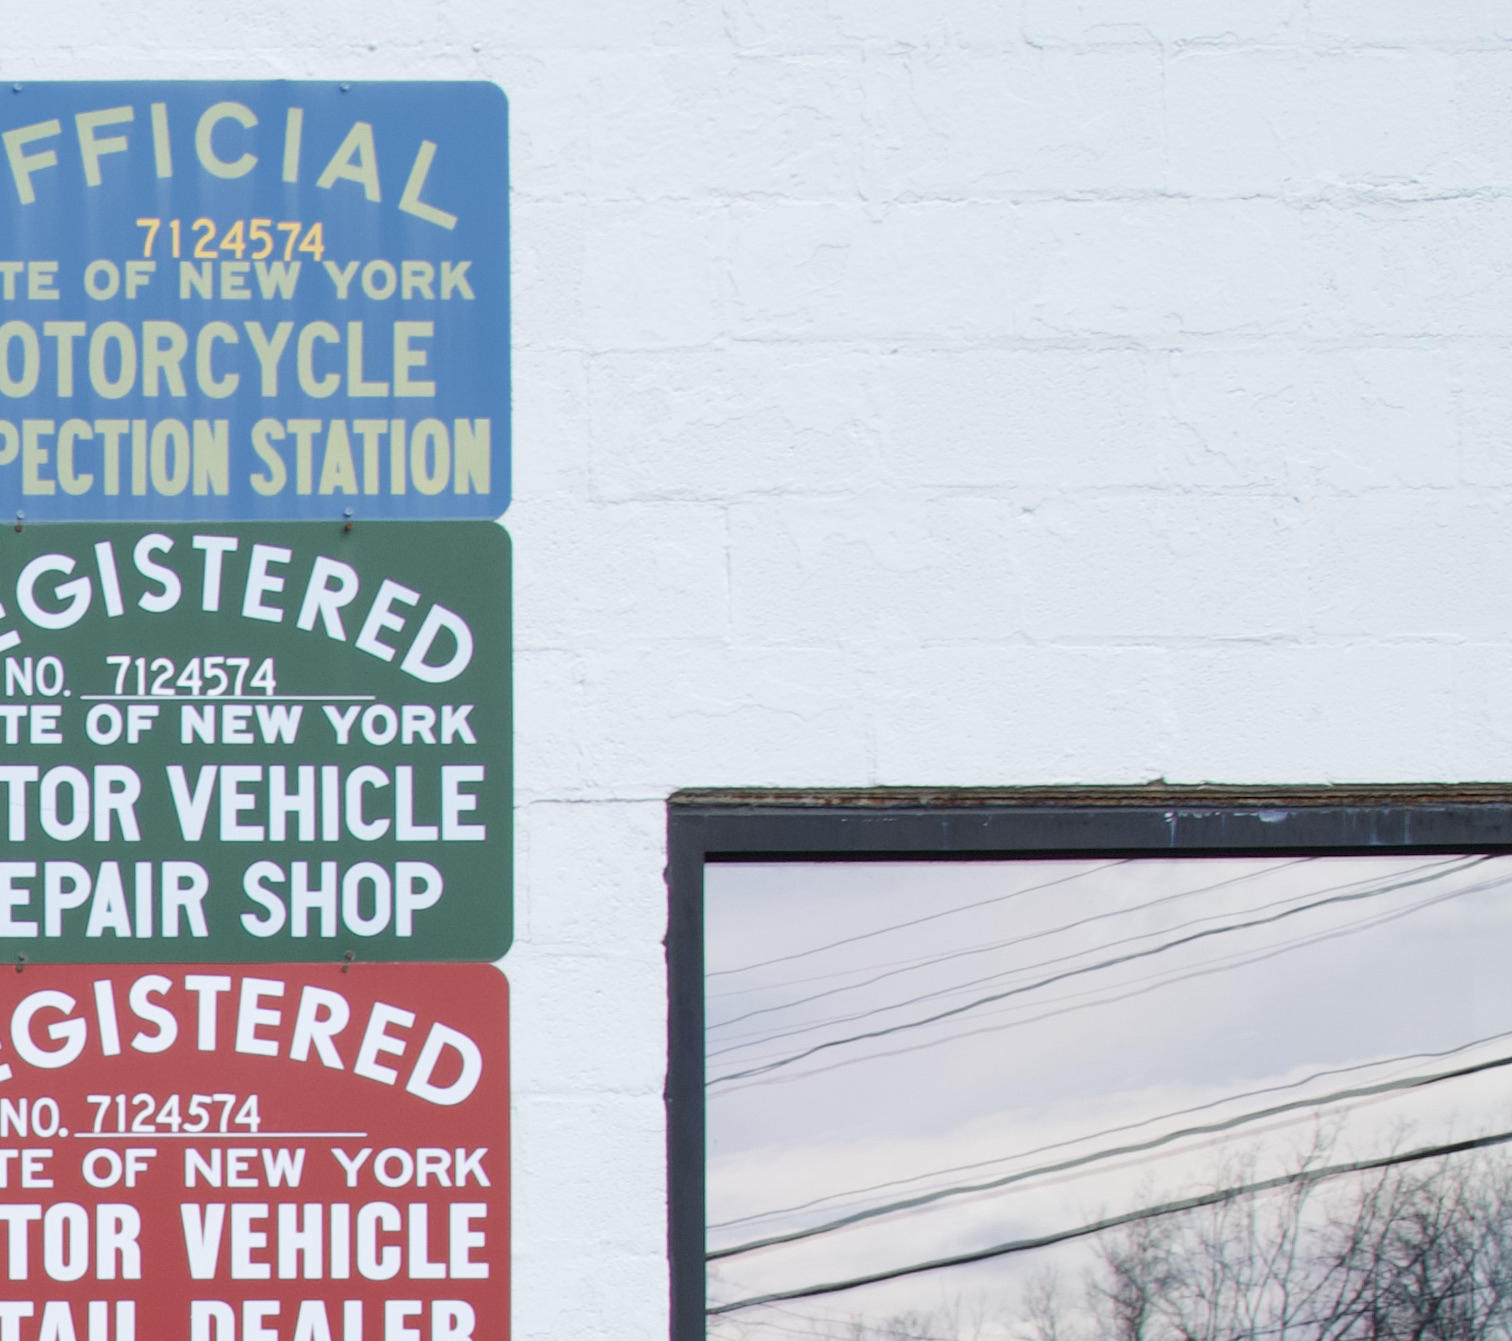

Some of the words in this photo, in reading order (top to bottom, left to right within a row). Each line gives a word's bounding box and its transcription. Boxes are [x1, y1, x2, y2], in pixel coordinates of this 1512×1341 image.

[136, 218, 324, 261] 7124574
[84, 260, 156, 300] OF
[180, 260, 301, 300] NEW
[324, 260, 475, 300] YORK
[251, 418, 490, 495] STATION
[6, 656, 71, 697] NO.
[106, 656, 276, 696] 7124574
[86, 704, 159, 744] OF
[181, 705, 302, 744] NEW
[323, 704, 476, 744] YORK
[167, 765, 485, 841] VEHICLE
[241, 861, 443, 938] SHOP
[0, 1098, 68, 1137] NO.
[87, 1094, 260, 1133] 7124574
[82, 1148, 156, 1188] OF
[185, 1148, 305, 1187] NEW
[333, 1148, 490, 1187] YORK
[180, 1202, 489, 1280] VEHICLE
